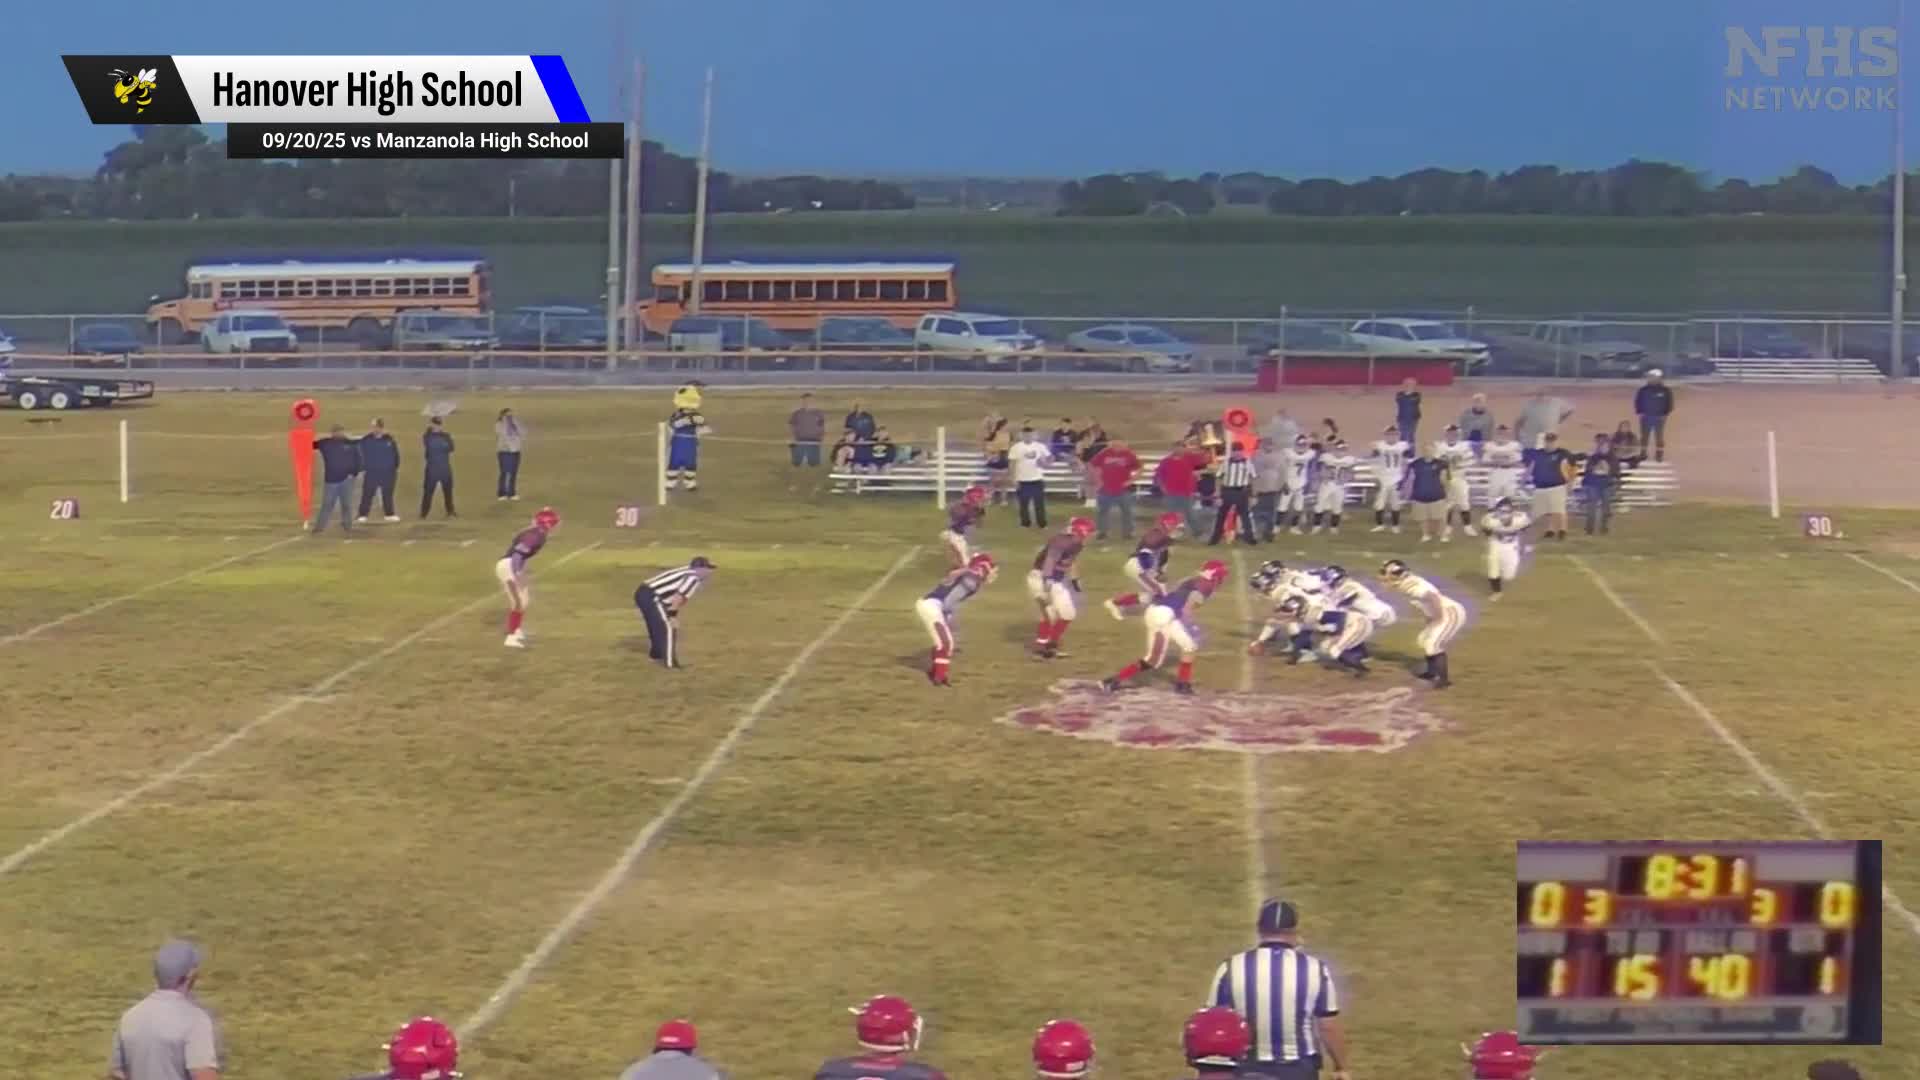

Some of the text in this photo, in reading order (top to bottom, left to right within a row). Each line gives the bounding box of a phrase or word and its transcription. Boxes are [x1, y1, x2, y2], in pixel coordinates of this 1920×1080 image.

[50, 500, 73, 519] 20
[615, 507, 638, 527] 30
[1808, 516, 1832, 536] 30
[1645, 855, 1745, 898] 8:31
[1531, 882, 1565, 926] 0
[1584, 890, 1611, 924] 3
[1752, 890, 1777, 924] 3
[1820, 882, 1856, 926] 0
[1551, 958, 1566, 996] 1
[1615, 954, 1659, 999] 15
[1690, 954, 1749, 999] 40
[1821, 957, 1836, 994] 1
